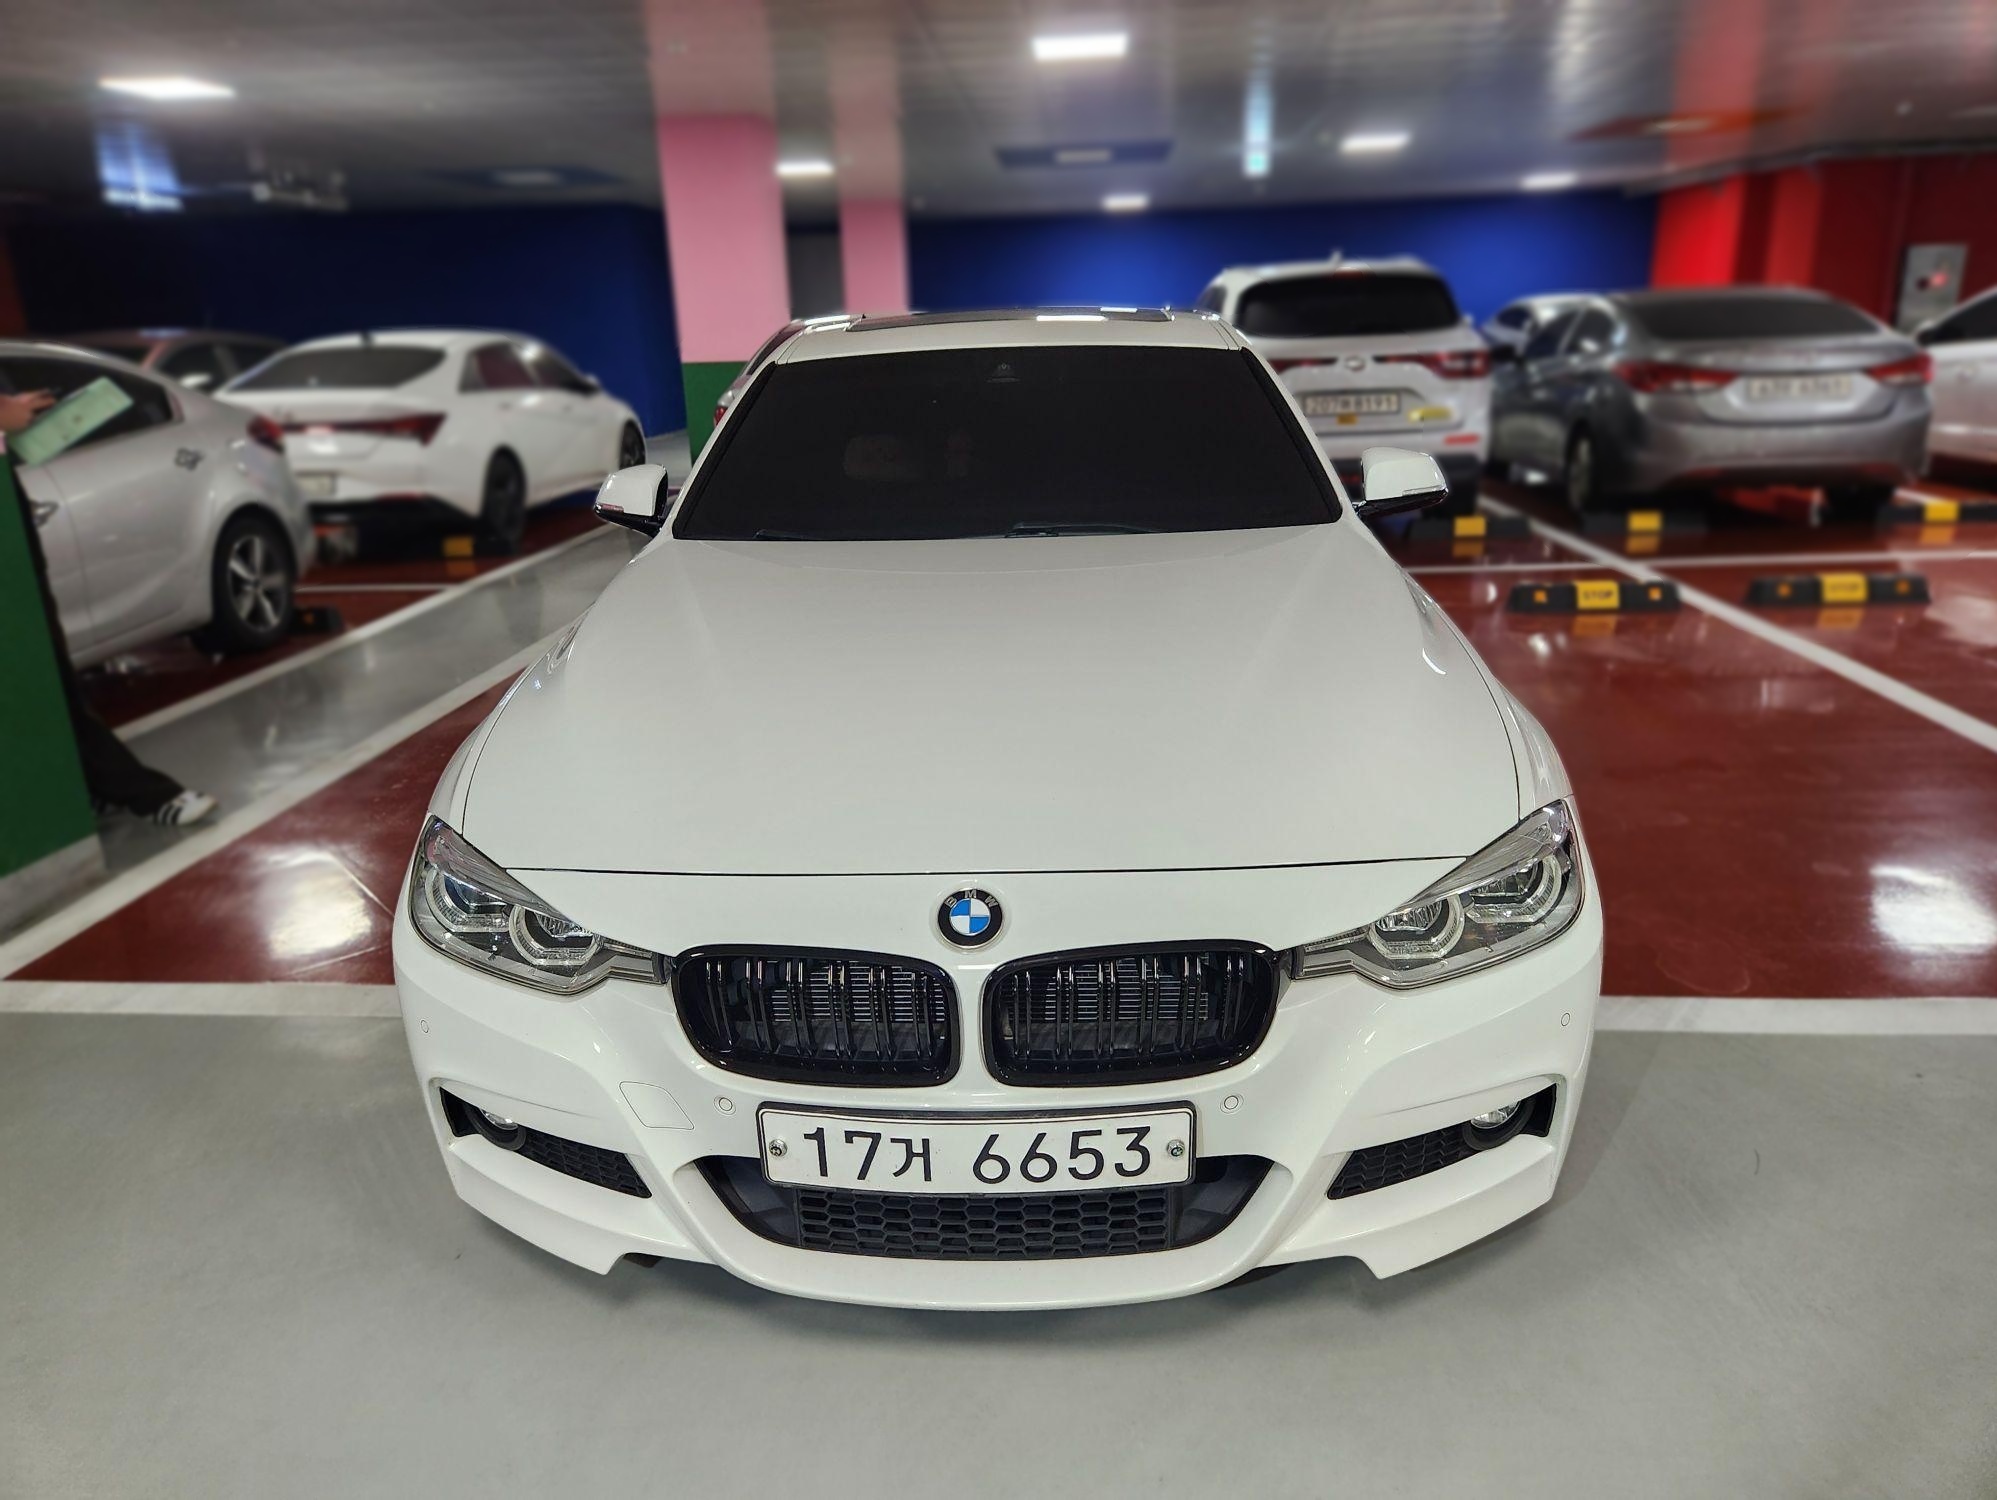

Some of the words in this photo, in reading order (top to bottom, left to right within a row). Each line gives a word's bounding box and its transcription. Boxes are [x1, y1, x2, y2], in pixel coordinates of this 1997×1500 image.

[944, 888, 999, 908] BMW
[803, 1126, 932, 1182] 17거
[972, 1125, 1152, 1184] 6653
